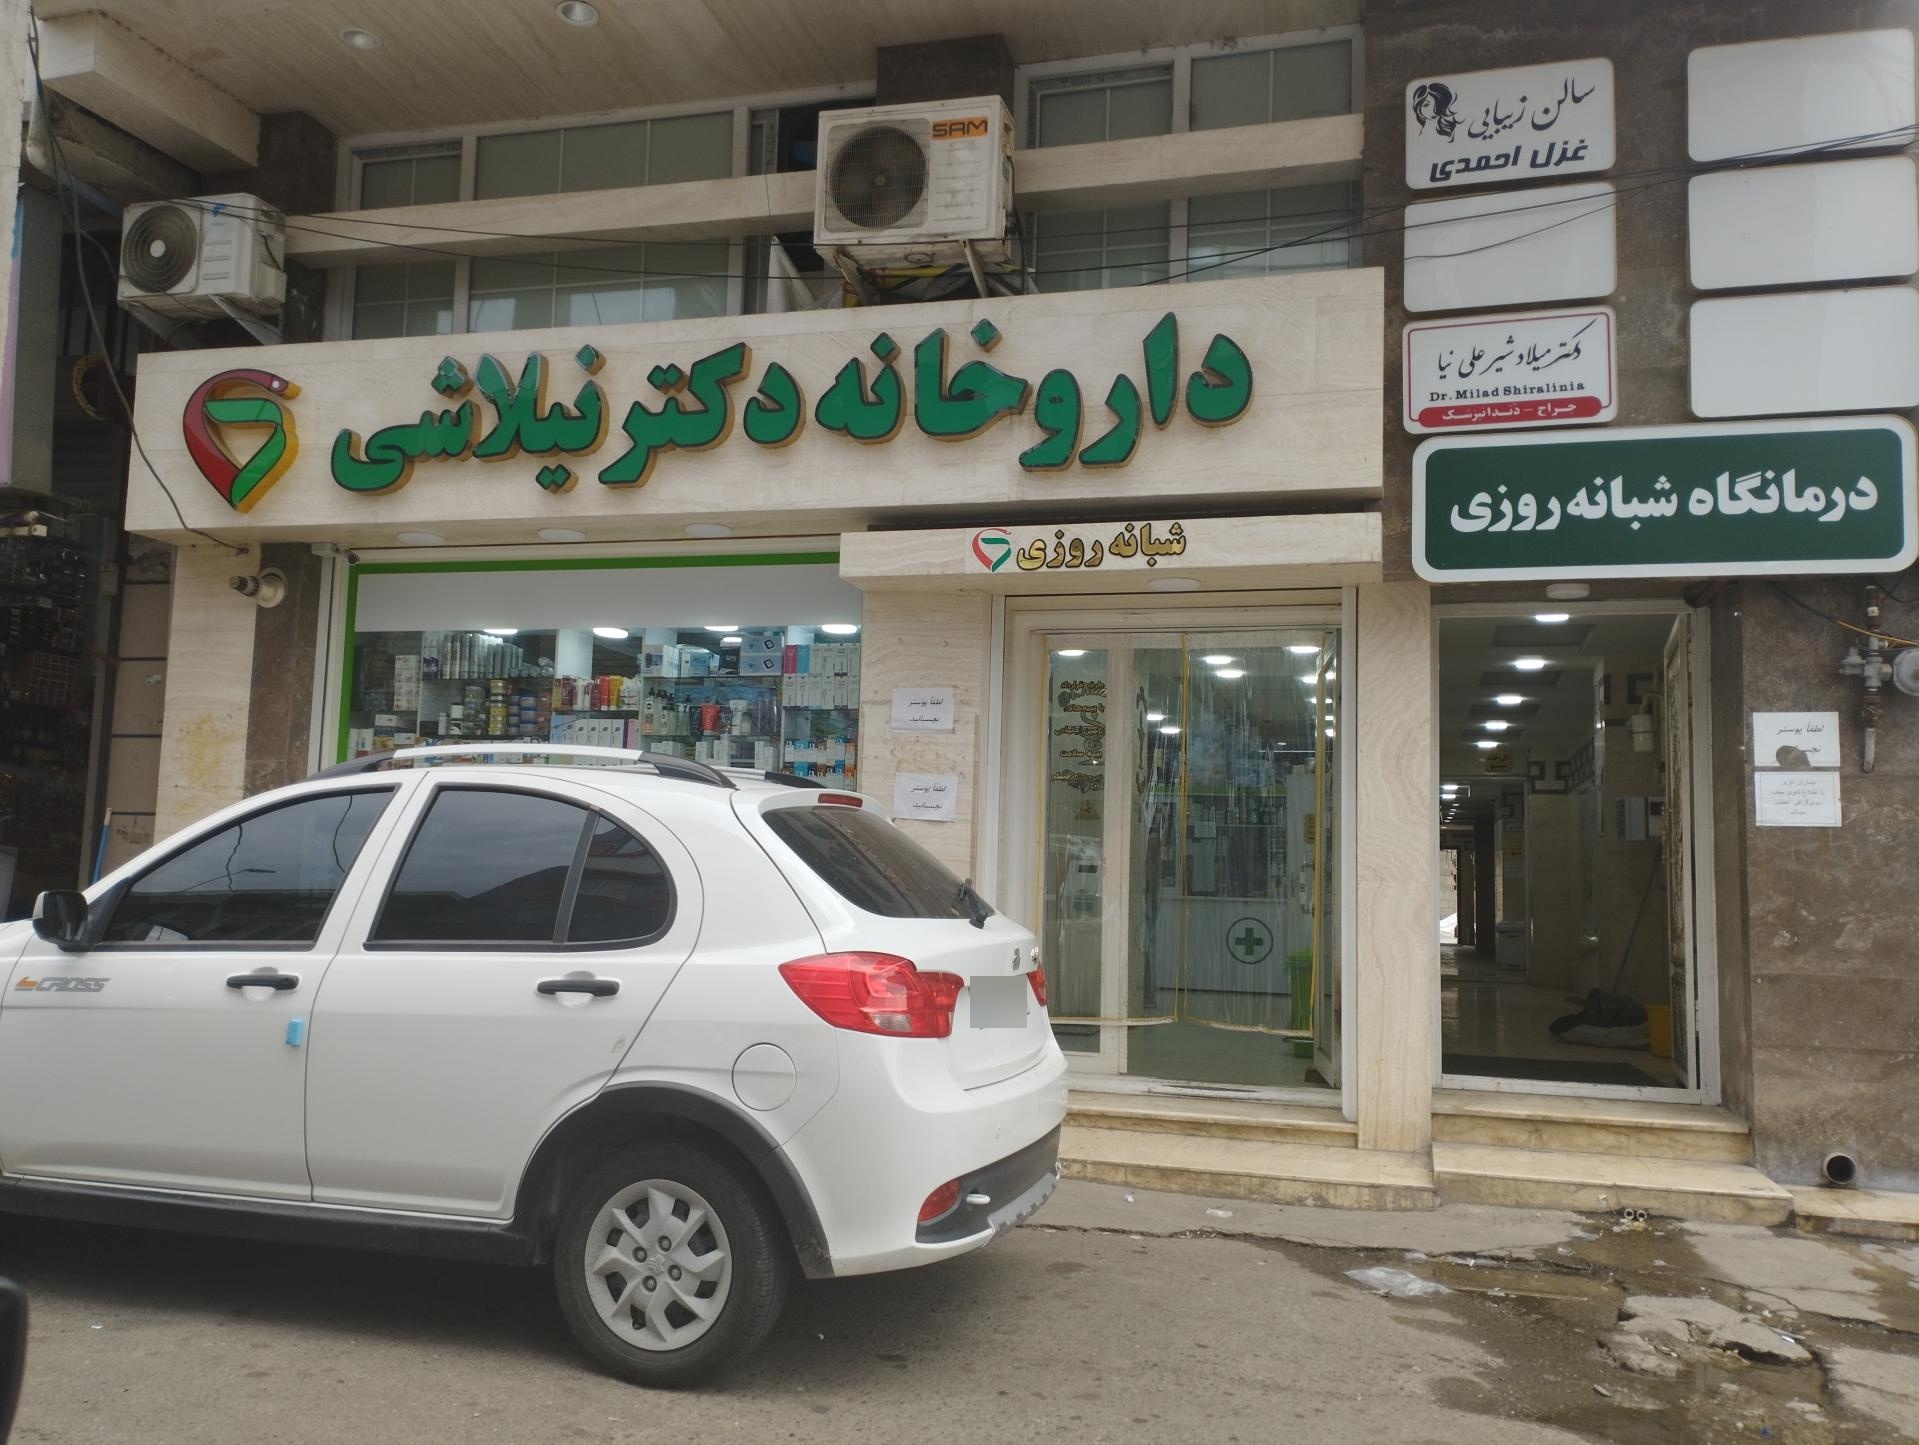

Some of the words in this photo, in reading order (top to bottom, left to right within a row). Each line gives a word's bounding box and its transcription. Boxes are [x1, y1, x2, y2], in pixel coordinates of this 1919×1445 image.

[1467, 96, 1528, 141] زیبایی
[1531, 72, 1596, 131] سالن
[932, 119, 988, 138] SAM
[1429, 145, 1522, 183] احمدی
[1530, 138, 1589, 169] غزل
[1515, 343, 1552, 371] میلاد
[1541, 318, 1597, 369] دکتر
[814, 311, 1253, 472] داروخانه
[1456, 385, 1500, 400] Milad
[1503, 380, 1586, 396] Shiralinia
[1537, 402, 1577, 416] جراح
[330, 344, 610, 496] نیلاشی
[598, 341, 806, 488] دکتر
[1442, 402, 1520, 422] دندانپزشک
[1688, 468, 1879, 522] درمانگاه
[1016, 529, 1104, 571] روزی
[1108, 521, 1187, 568] شبانه
